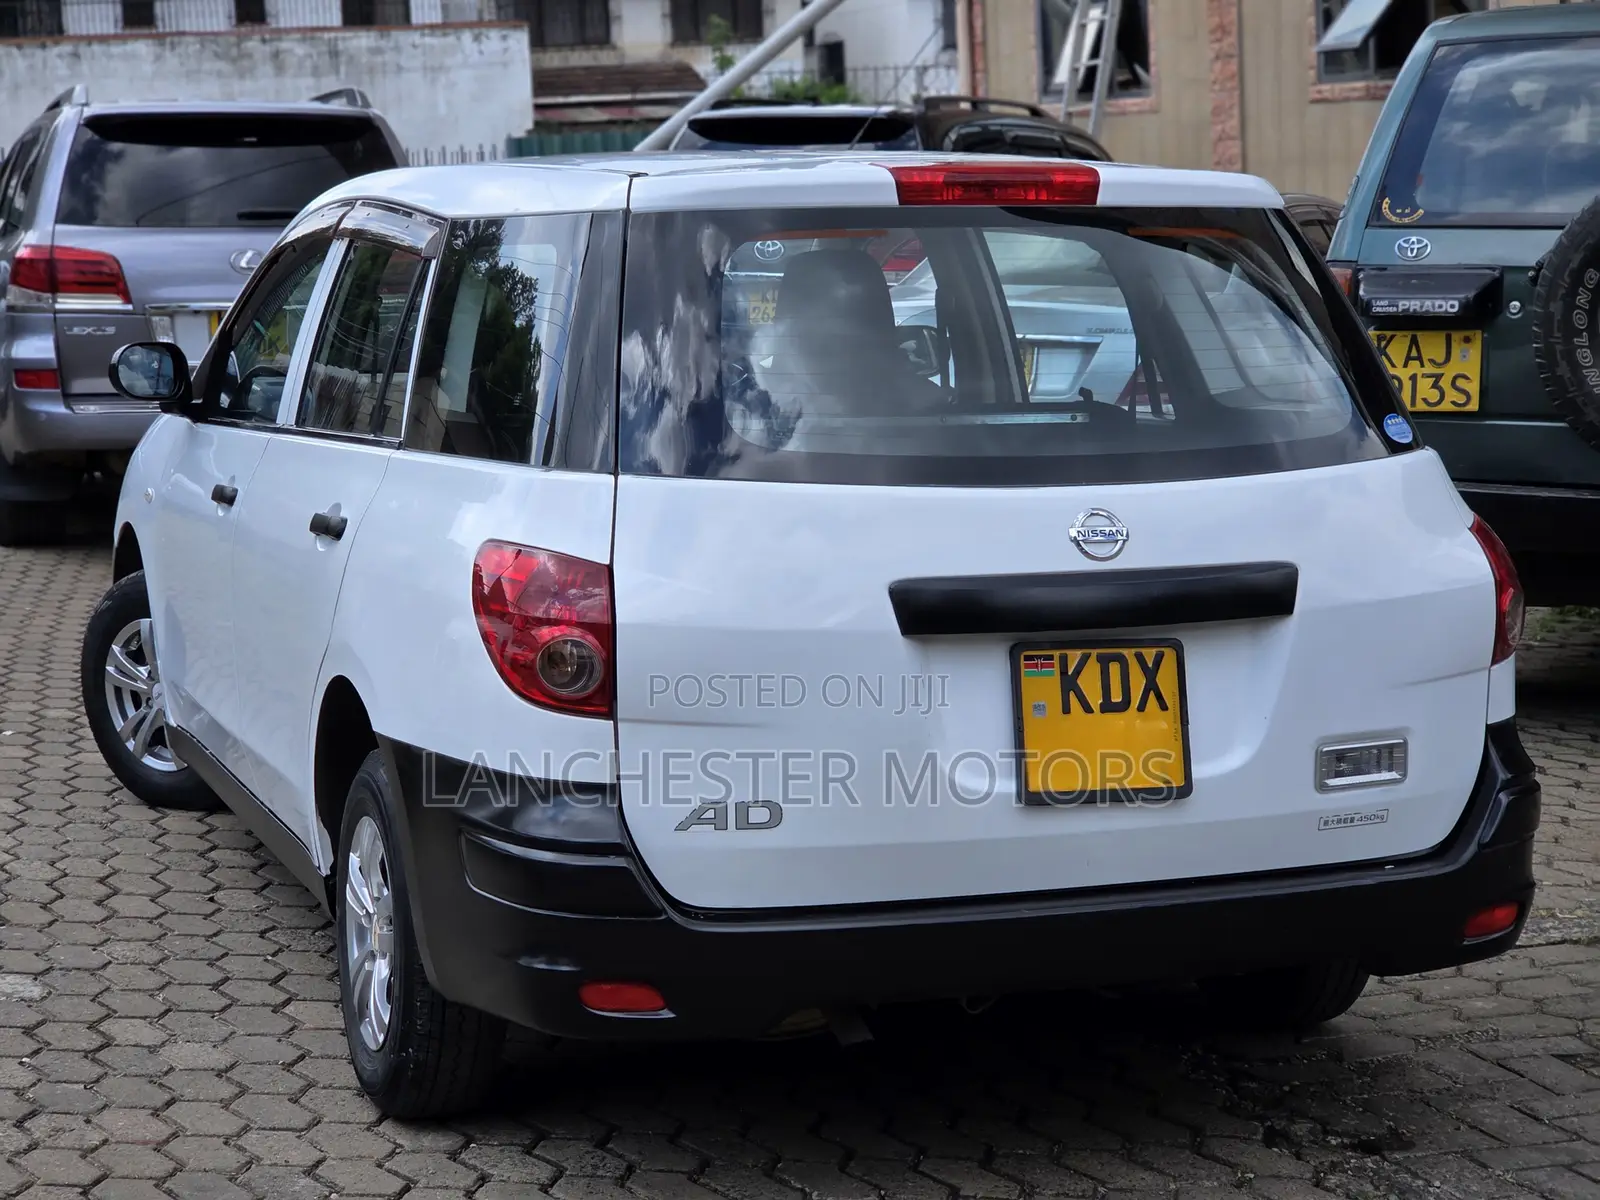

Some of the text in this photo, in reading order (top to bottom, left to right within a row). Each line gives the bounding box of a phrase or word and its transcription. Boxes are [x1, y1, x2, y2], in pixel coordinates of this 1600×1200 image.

[1398, 300, 1459, 313] PRADO
[1376, 332, 1452, 369] KAJ
[1076, 529, 1124, 538] NISSAN
[1059, 651, 1169, 715] KDX
[674, 800, 783, 831] AD
